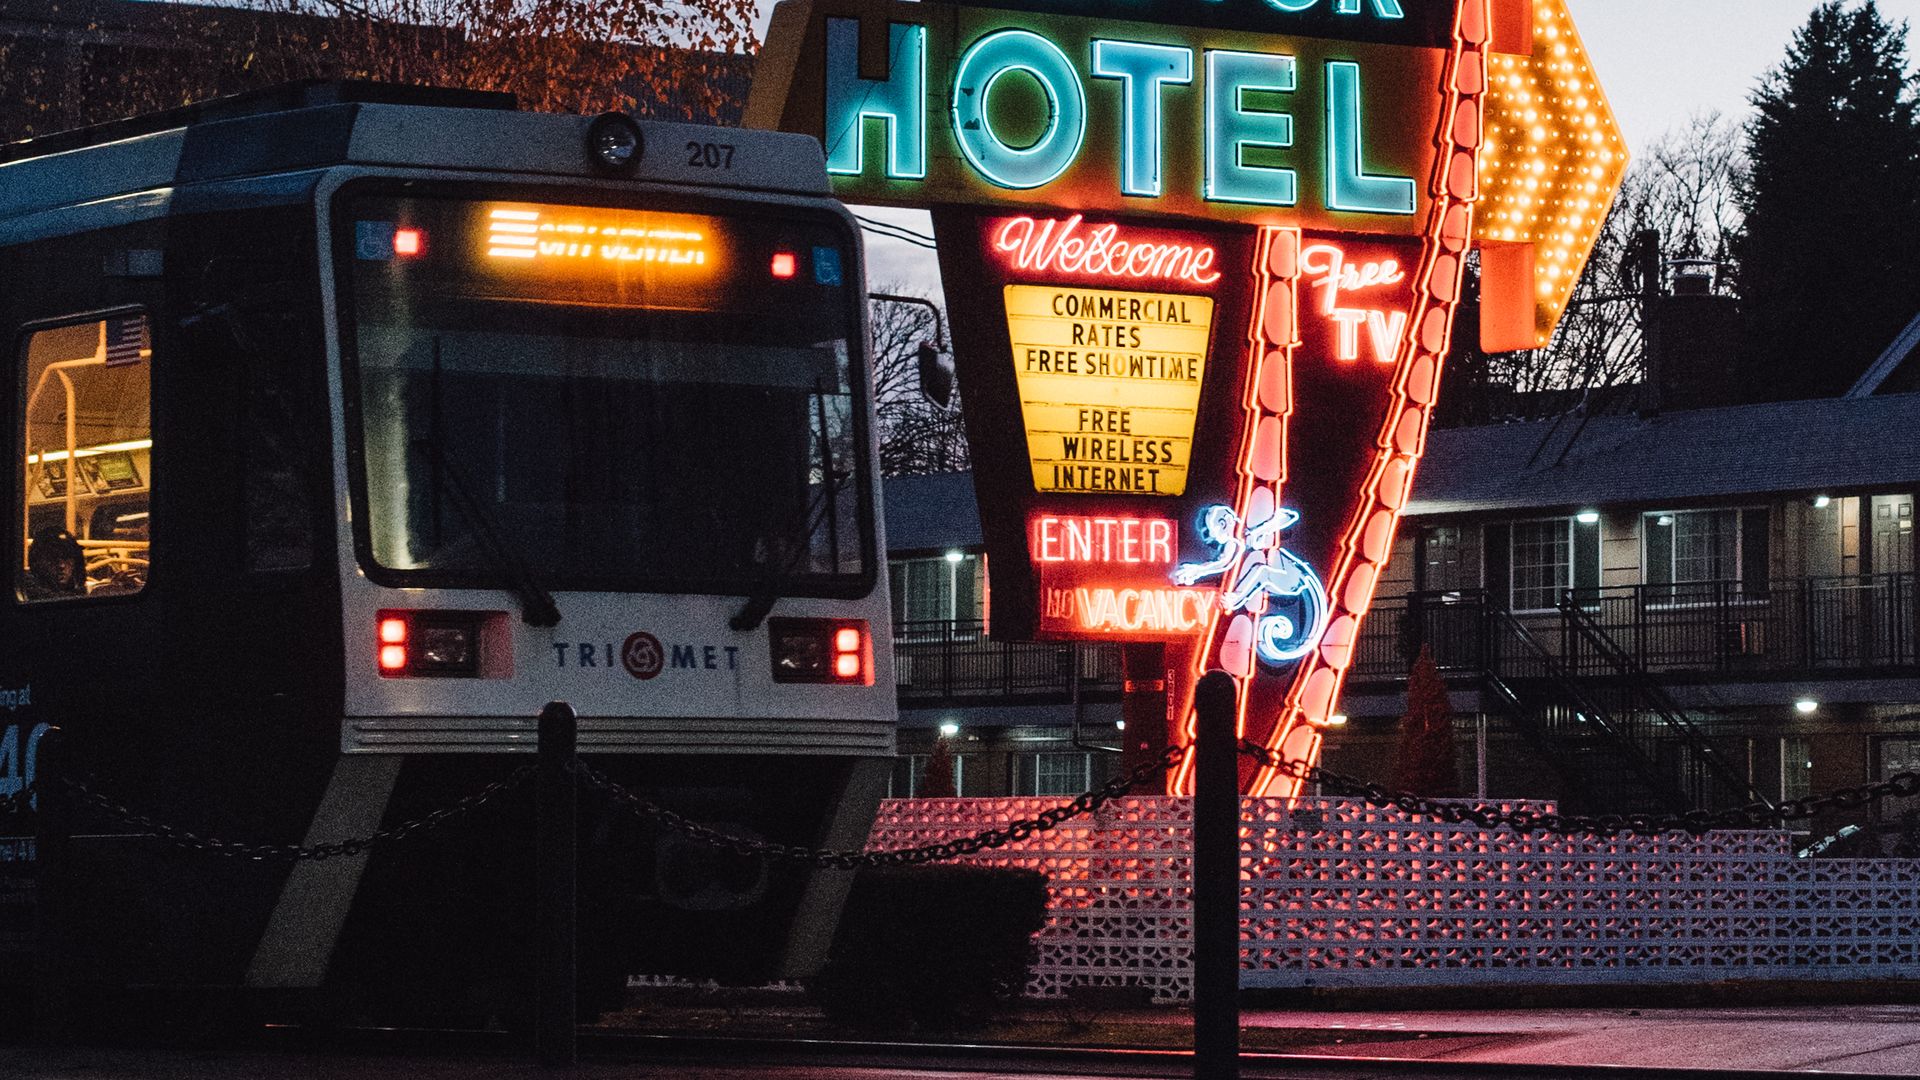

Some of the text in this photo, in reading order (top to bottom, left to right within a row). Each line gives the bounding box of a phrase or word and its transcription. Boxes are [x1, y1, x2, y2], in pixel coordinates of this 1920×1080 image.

[825, 16, 1418, 214] HOTEL
[686, 141, 737, 170] 207
[997, 213, 1221, 284] Welcome
[1300, 244, 1405, 316] Free
[1052, 293, 1191, 323] COMMERCIAL
[1072, 323, 1141, 348] RATES
[1331, 307, 1408, 363] TV
[1026, 349, 1198, 380] FREE SHOWTIME
[1078, 409, 1131, 433] FREE
[1063, 436, 1173, 463] WIRELESS
[1053, 465, 1160, 491] INTERNET
[1039, 518, 1171, 563] ENTER
[1047, 587, 1217, 632] NO VACANCY
